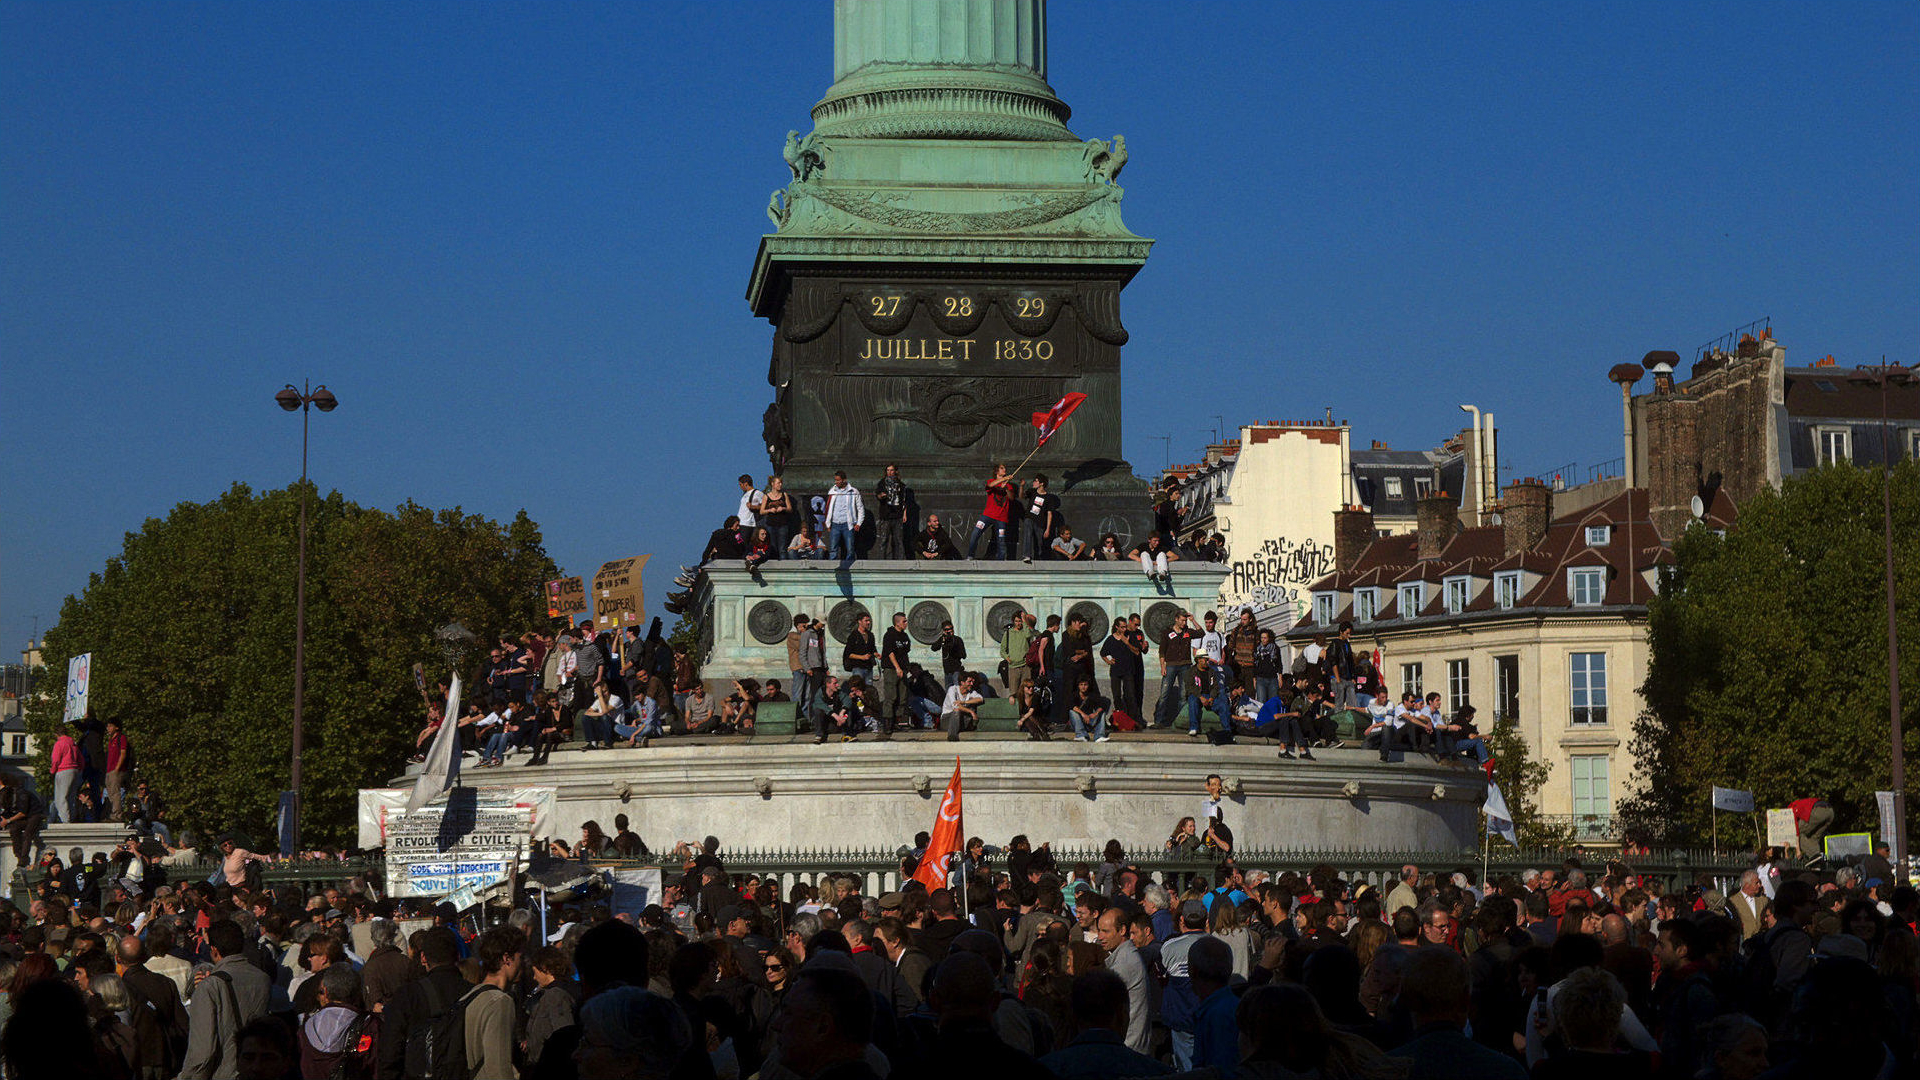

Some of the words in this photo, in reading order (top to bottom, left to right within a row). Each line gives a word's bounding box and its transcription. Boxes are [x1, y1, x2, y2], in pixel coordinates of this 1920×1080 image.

[871, 296, 901, 317] 27
[944, 296, 973, 317] 28
[1016, 297, 1045, 318] 29
[860, 339, 976, 360] JUILLET
[995, 340, 1054, 360] 1830
[471, 835, 512, 845] CIVILE
